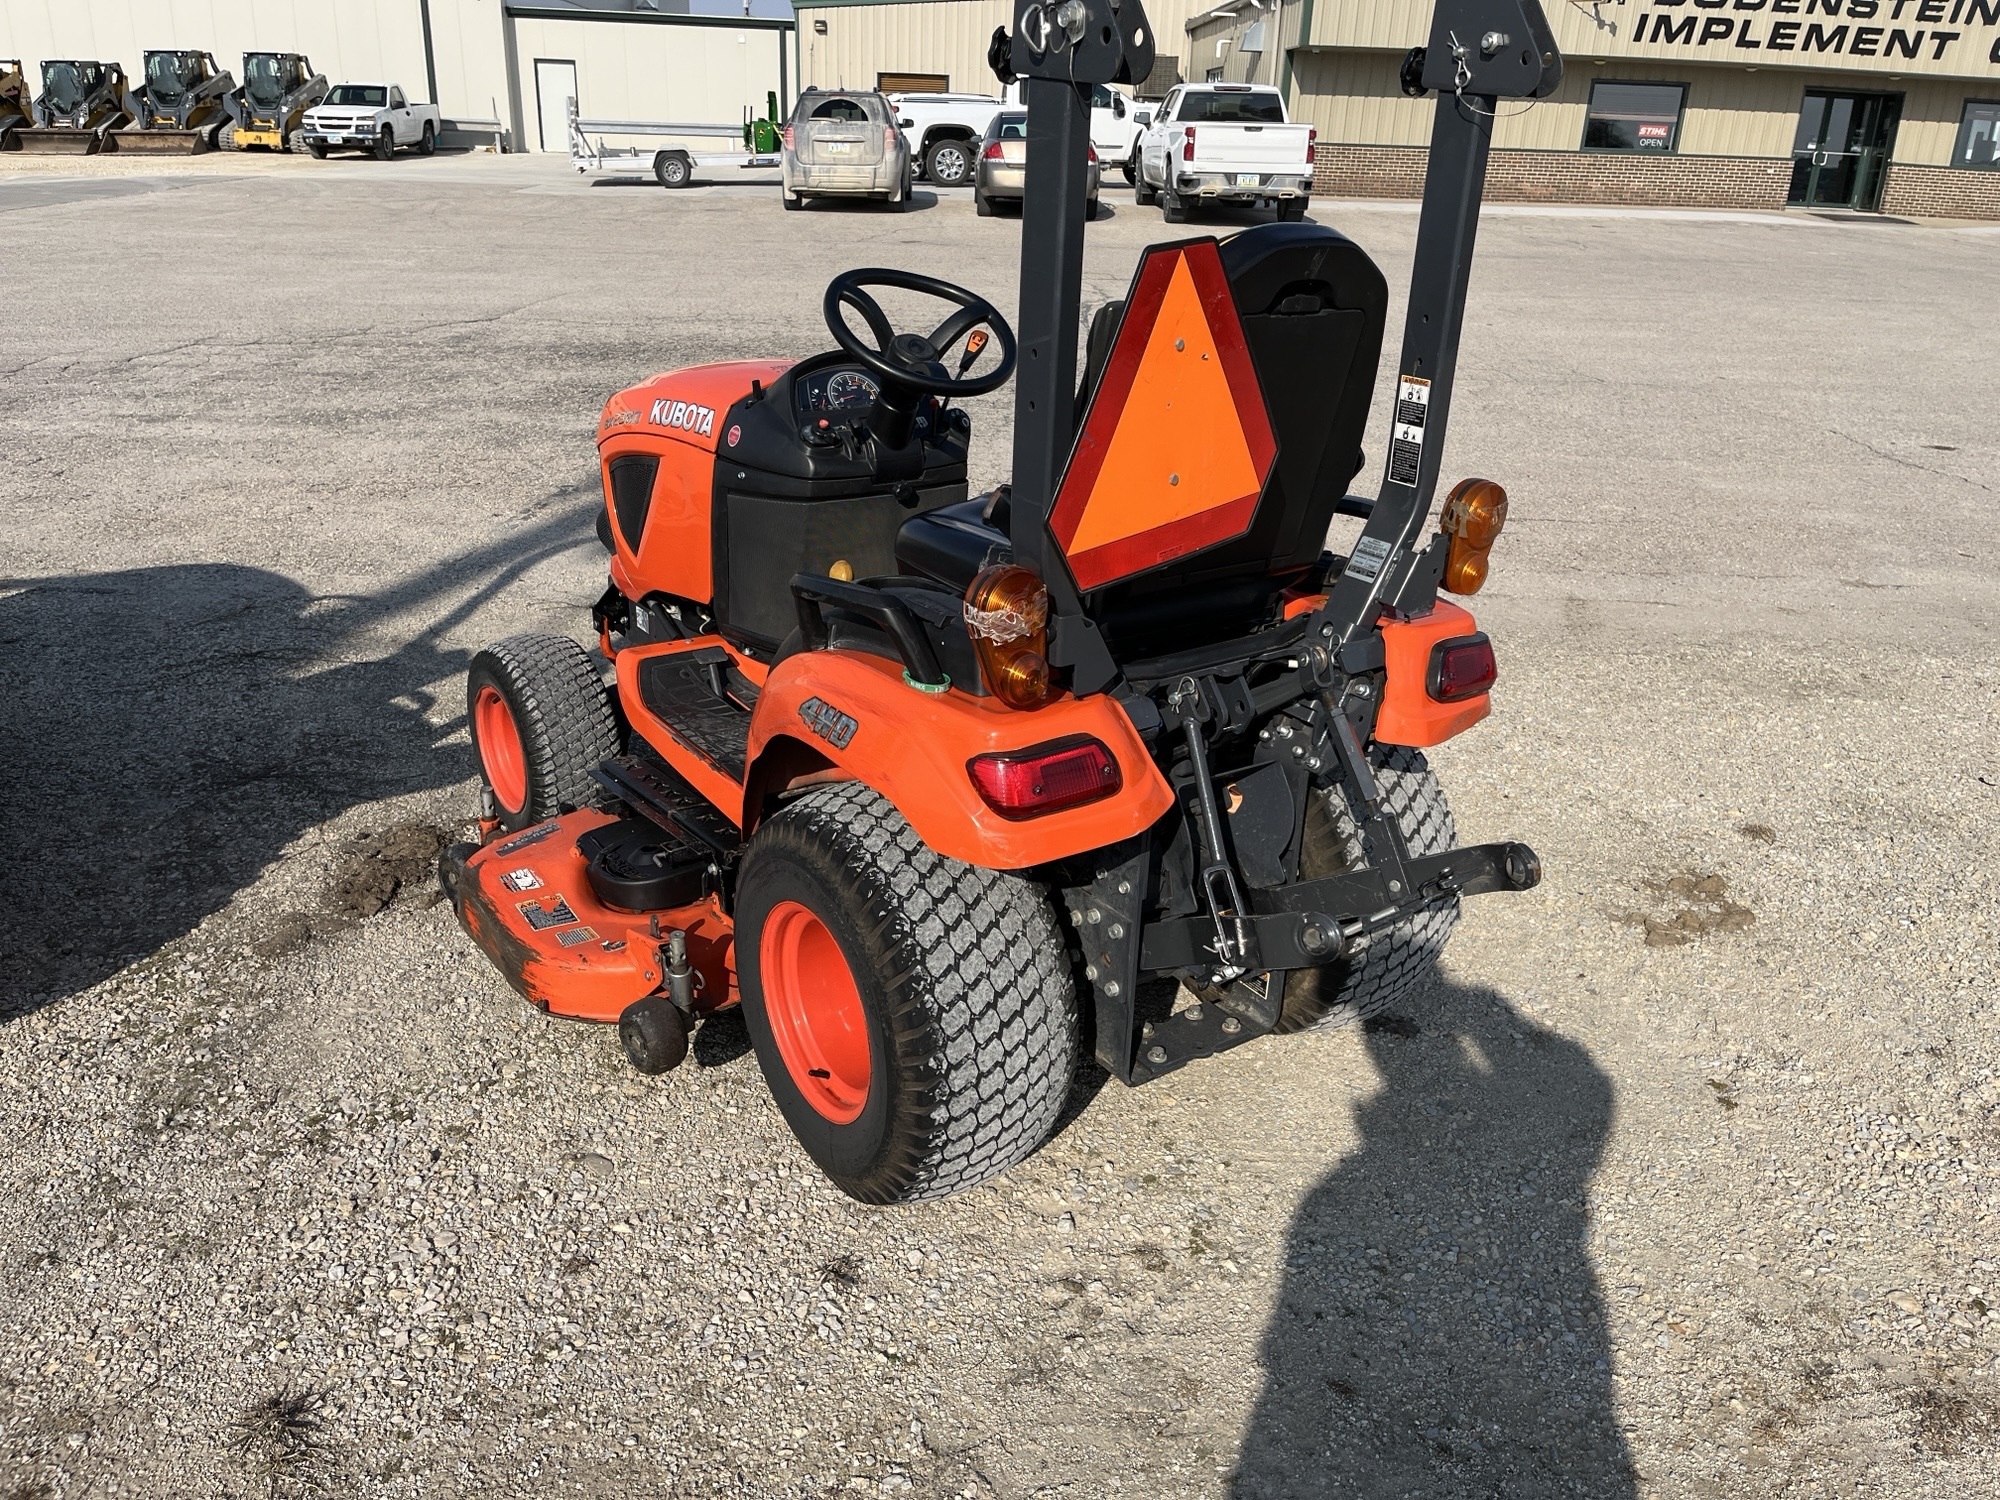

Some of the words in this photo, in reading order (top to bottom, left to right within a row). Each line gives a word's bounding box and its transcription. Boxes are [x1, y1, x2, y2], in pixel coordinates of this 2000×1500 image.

[1653, 0, 2000, 27] NSTEIN
[1632, 13, 1961, 60] IMPLEMENT
[1638, 127, 1667, 136] STIHL
[1639, 138, 1663, 147] OPEN
[650, 398, 715, 438] KUBOTA
[798, 696, 859, 750] 4WD
